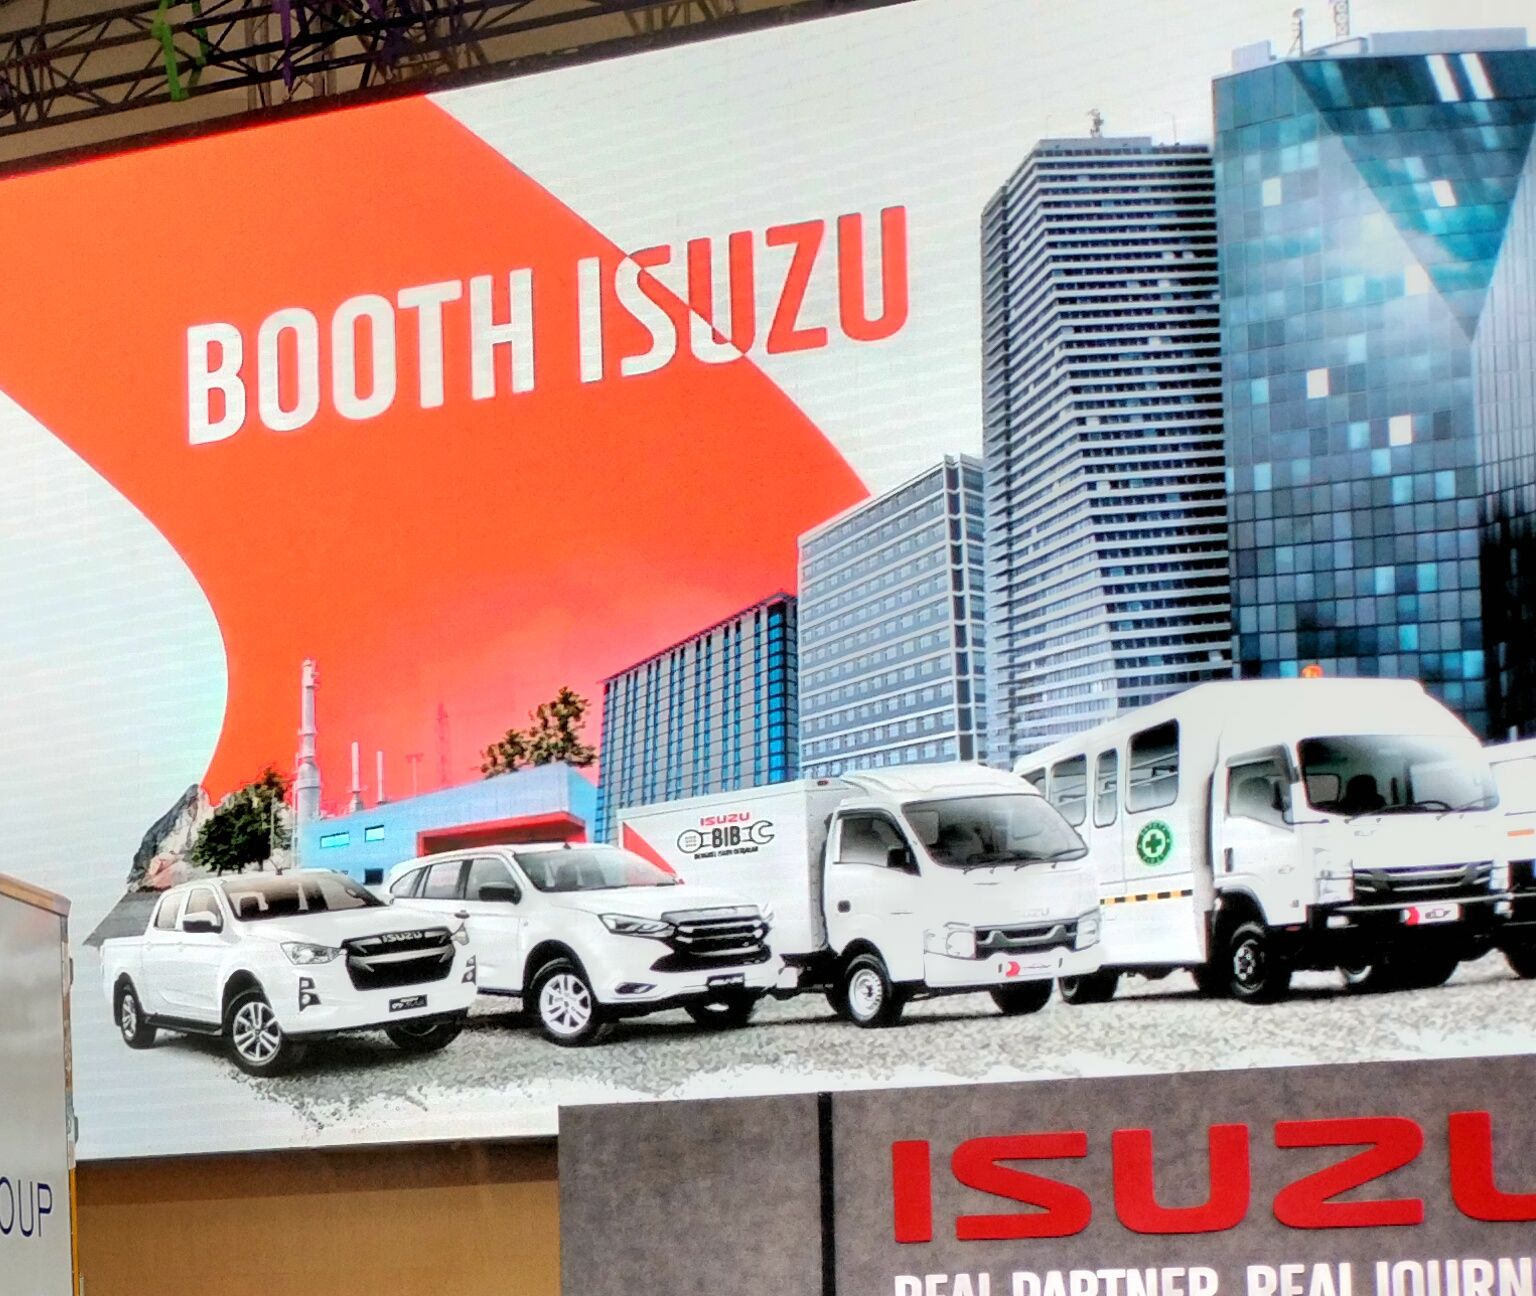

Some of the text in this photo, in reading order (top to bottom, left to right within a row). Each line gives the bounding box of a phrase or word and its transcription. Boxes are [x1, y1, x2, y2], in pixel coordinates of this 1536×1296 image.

[187, 205, 909, 446] BOOTH ISUZU
[700, 812, 750, 827] ISUZU
[712, 826, 741, 848] BIB
[382, 931, 423, 943] ISUZU
[892, 1111, 1536, 1244] ISUZU
